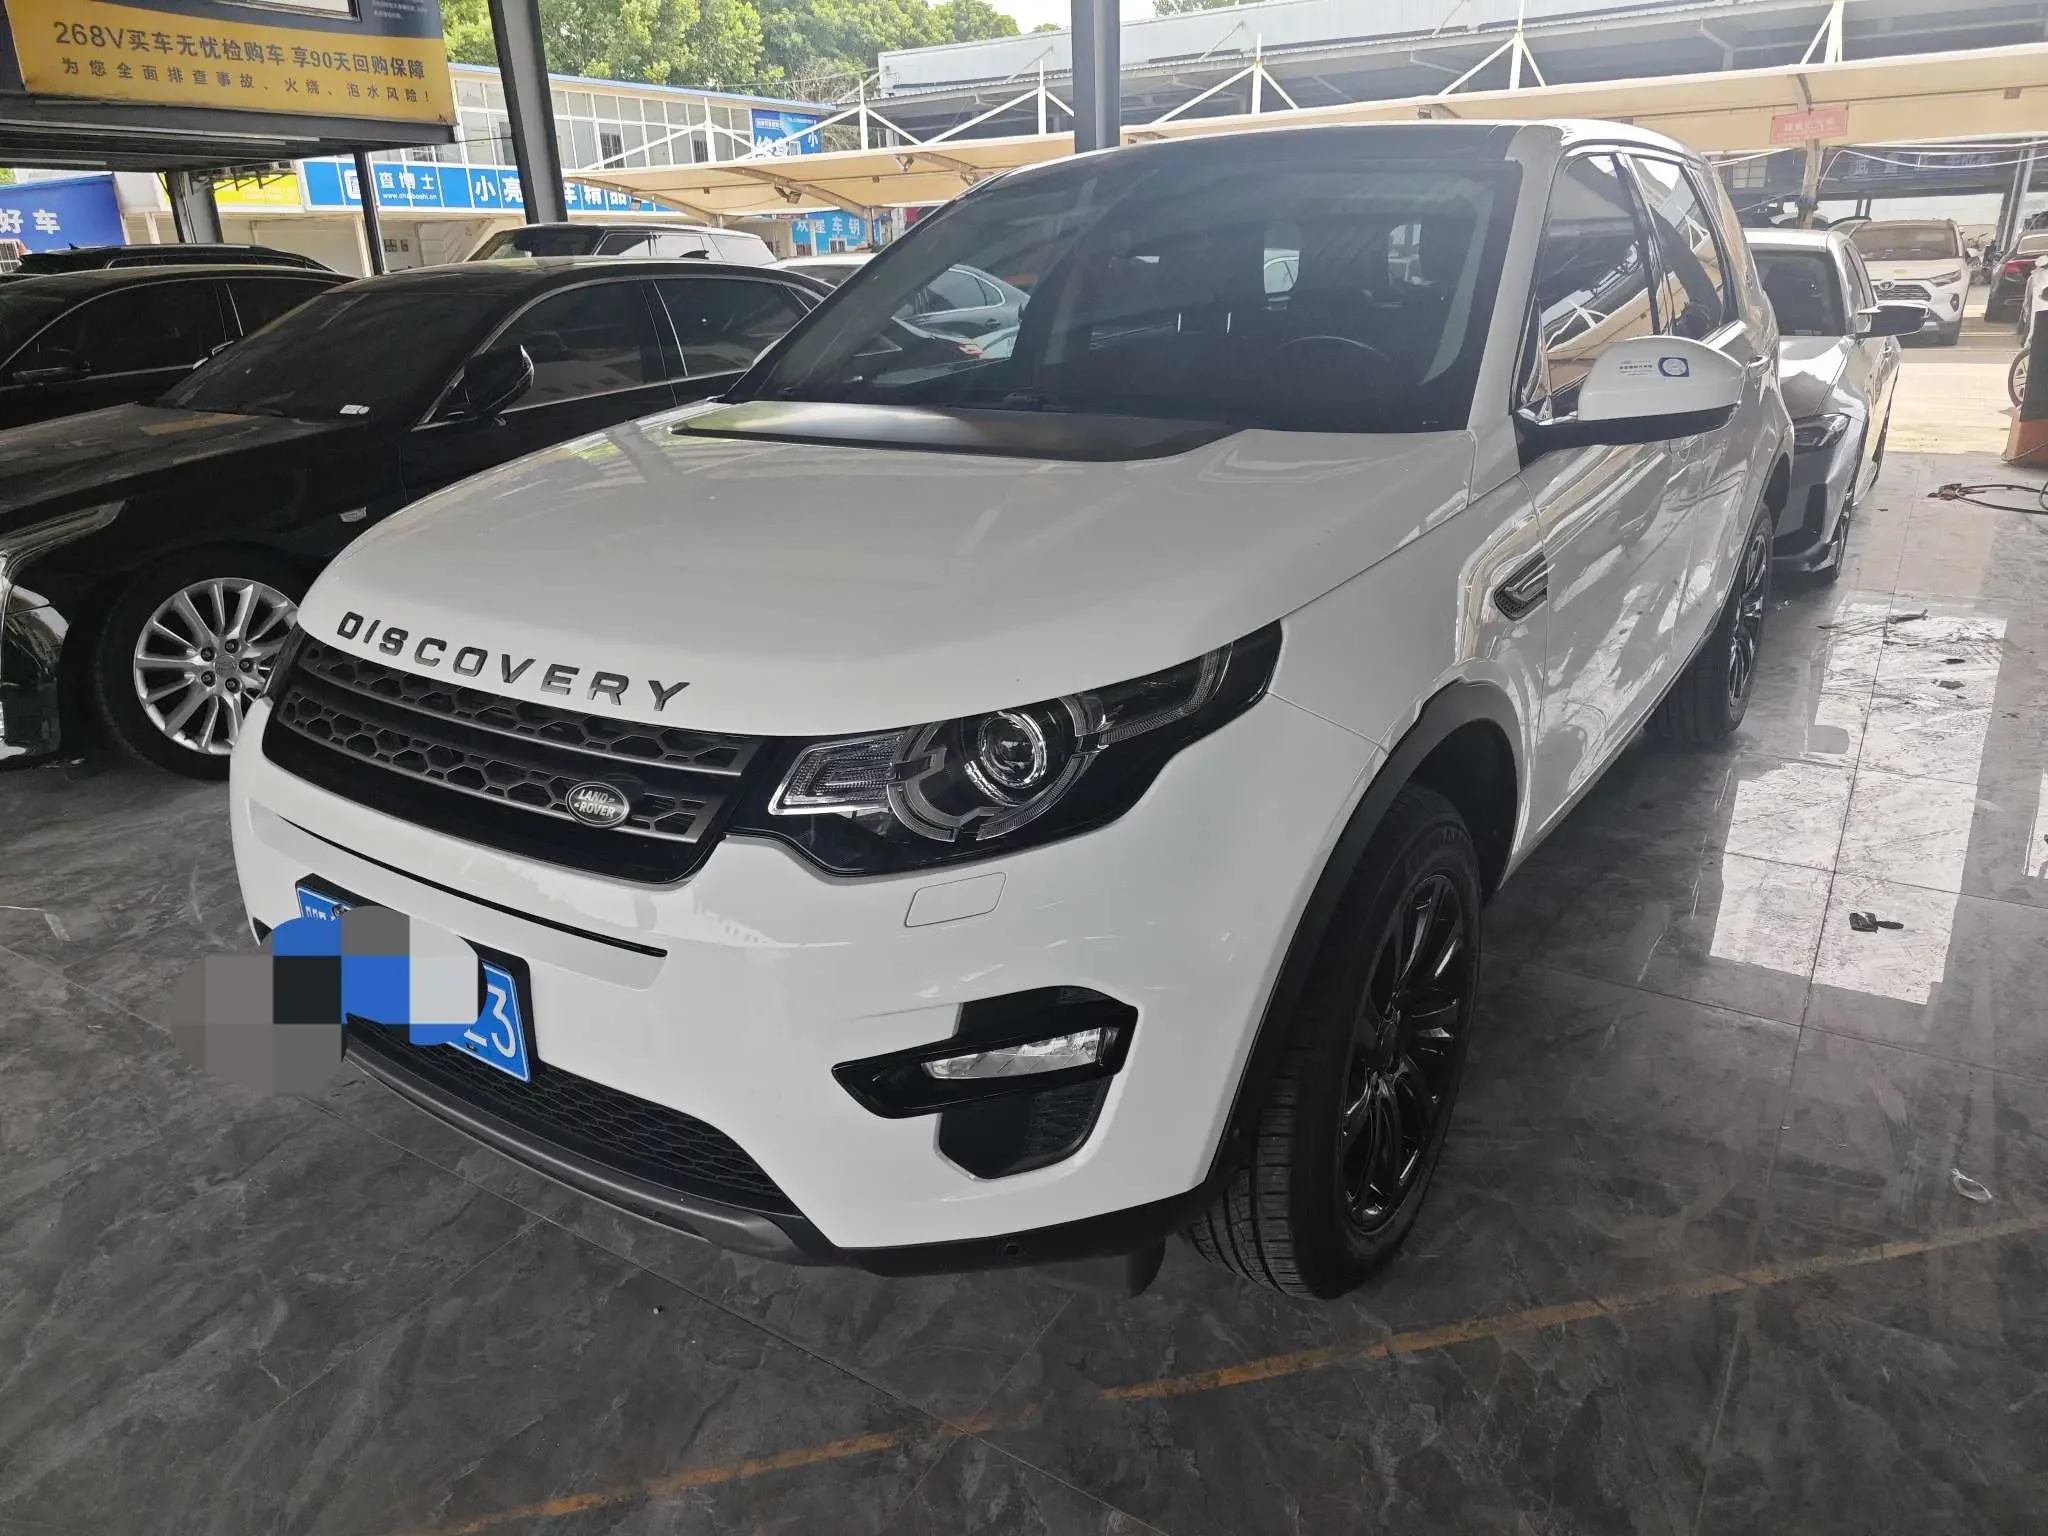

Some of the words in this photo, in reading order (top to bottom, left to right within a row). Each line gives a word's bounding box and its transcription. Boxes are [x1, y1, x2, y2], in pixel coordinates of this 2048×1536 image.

[53, 21, 285, 64] 268V买车无忧检购车
[291, 46, 425, 81] 享90天回购保障
[378, 171, 435, 190] 查博士
[336, 611, 691, 712] DISCOVERY
[577, 788, 609, 804] LAND
[579, 801, 616, 818] ROVER
